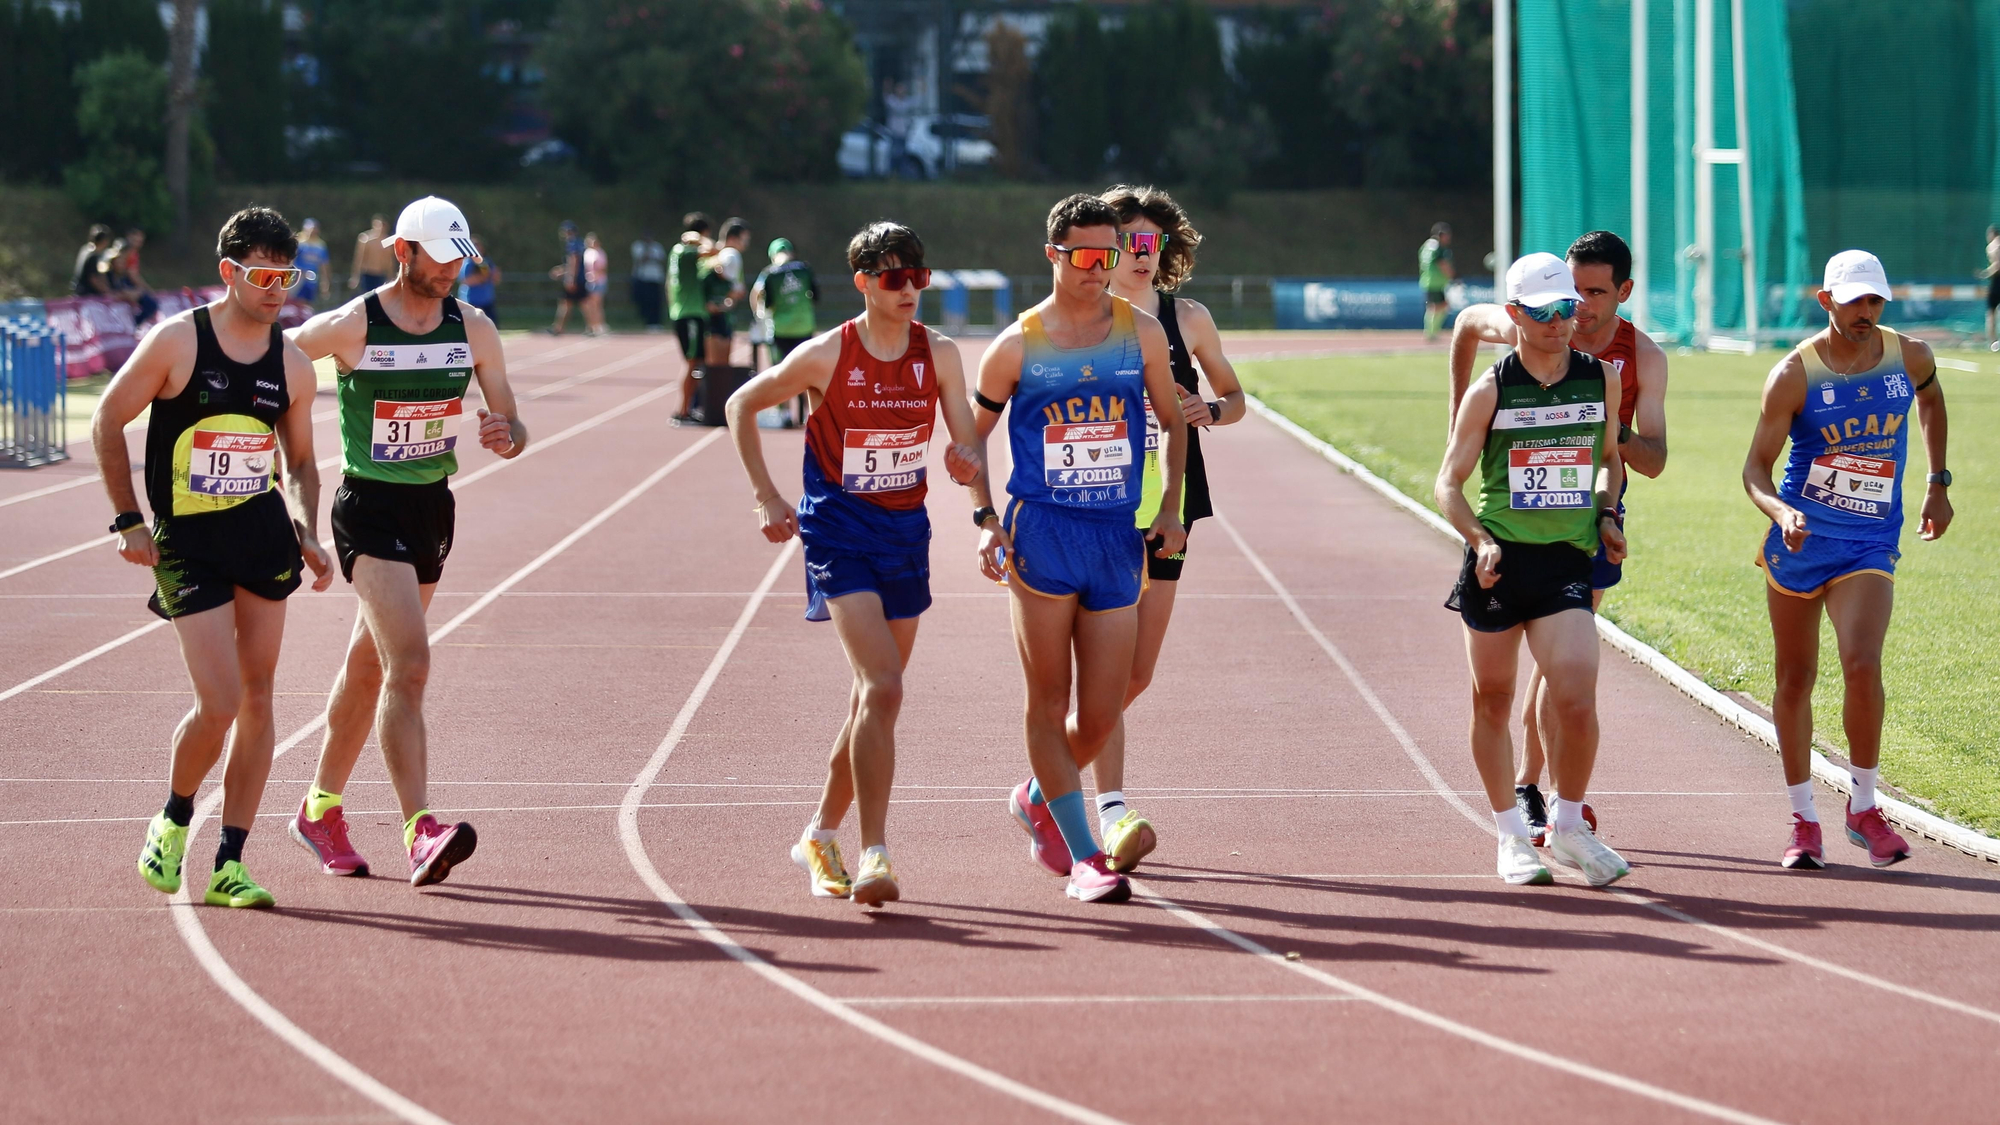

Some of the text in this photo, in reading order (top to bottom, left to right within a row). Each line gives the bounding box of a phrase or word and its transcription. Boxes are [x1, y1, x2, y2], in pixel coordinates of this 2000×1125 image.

[373, 388, 420, 398] ATLETISMO
[871, 400, 927, 408] MARATHON
[1043, 395, 1125, 425] UCAM
[388, 421, 411, 443] 31
[1820, 413, 1904, 445] UCAM
[1104, 446, 1123, 454] UCAM
[1513, 438, 1557, 449] ATLETISMO
[209, 452, 230, 476] 19
[865, 450, 877, 473] 5
[900, 449, 923, 463] ADM
[1062, 444, 1074, 467] 3
[1524, 467, 1547, 490] 32
[1824, 470, 1838, 490] 4
[1864, 481, 1884, 489] UCAM
